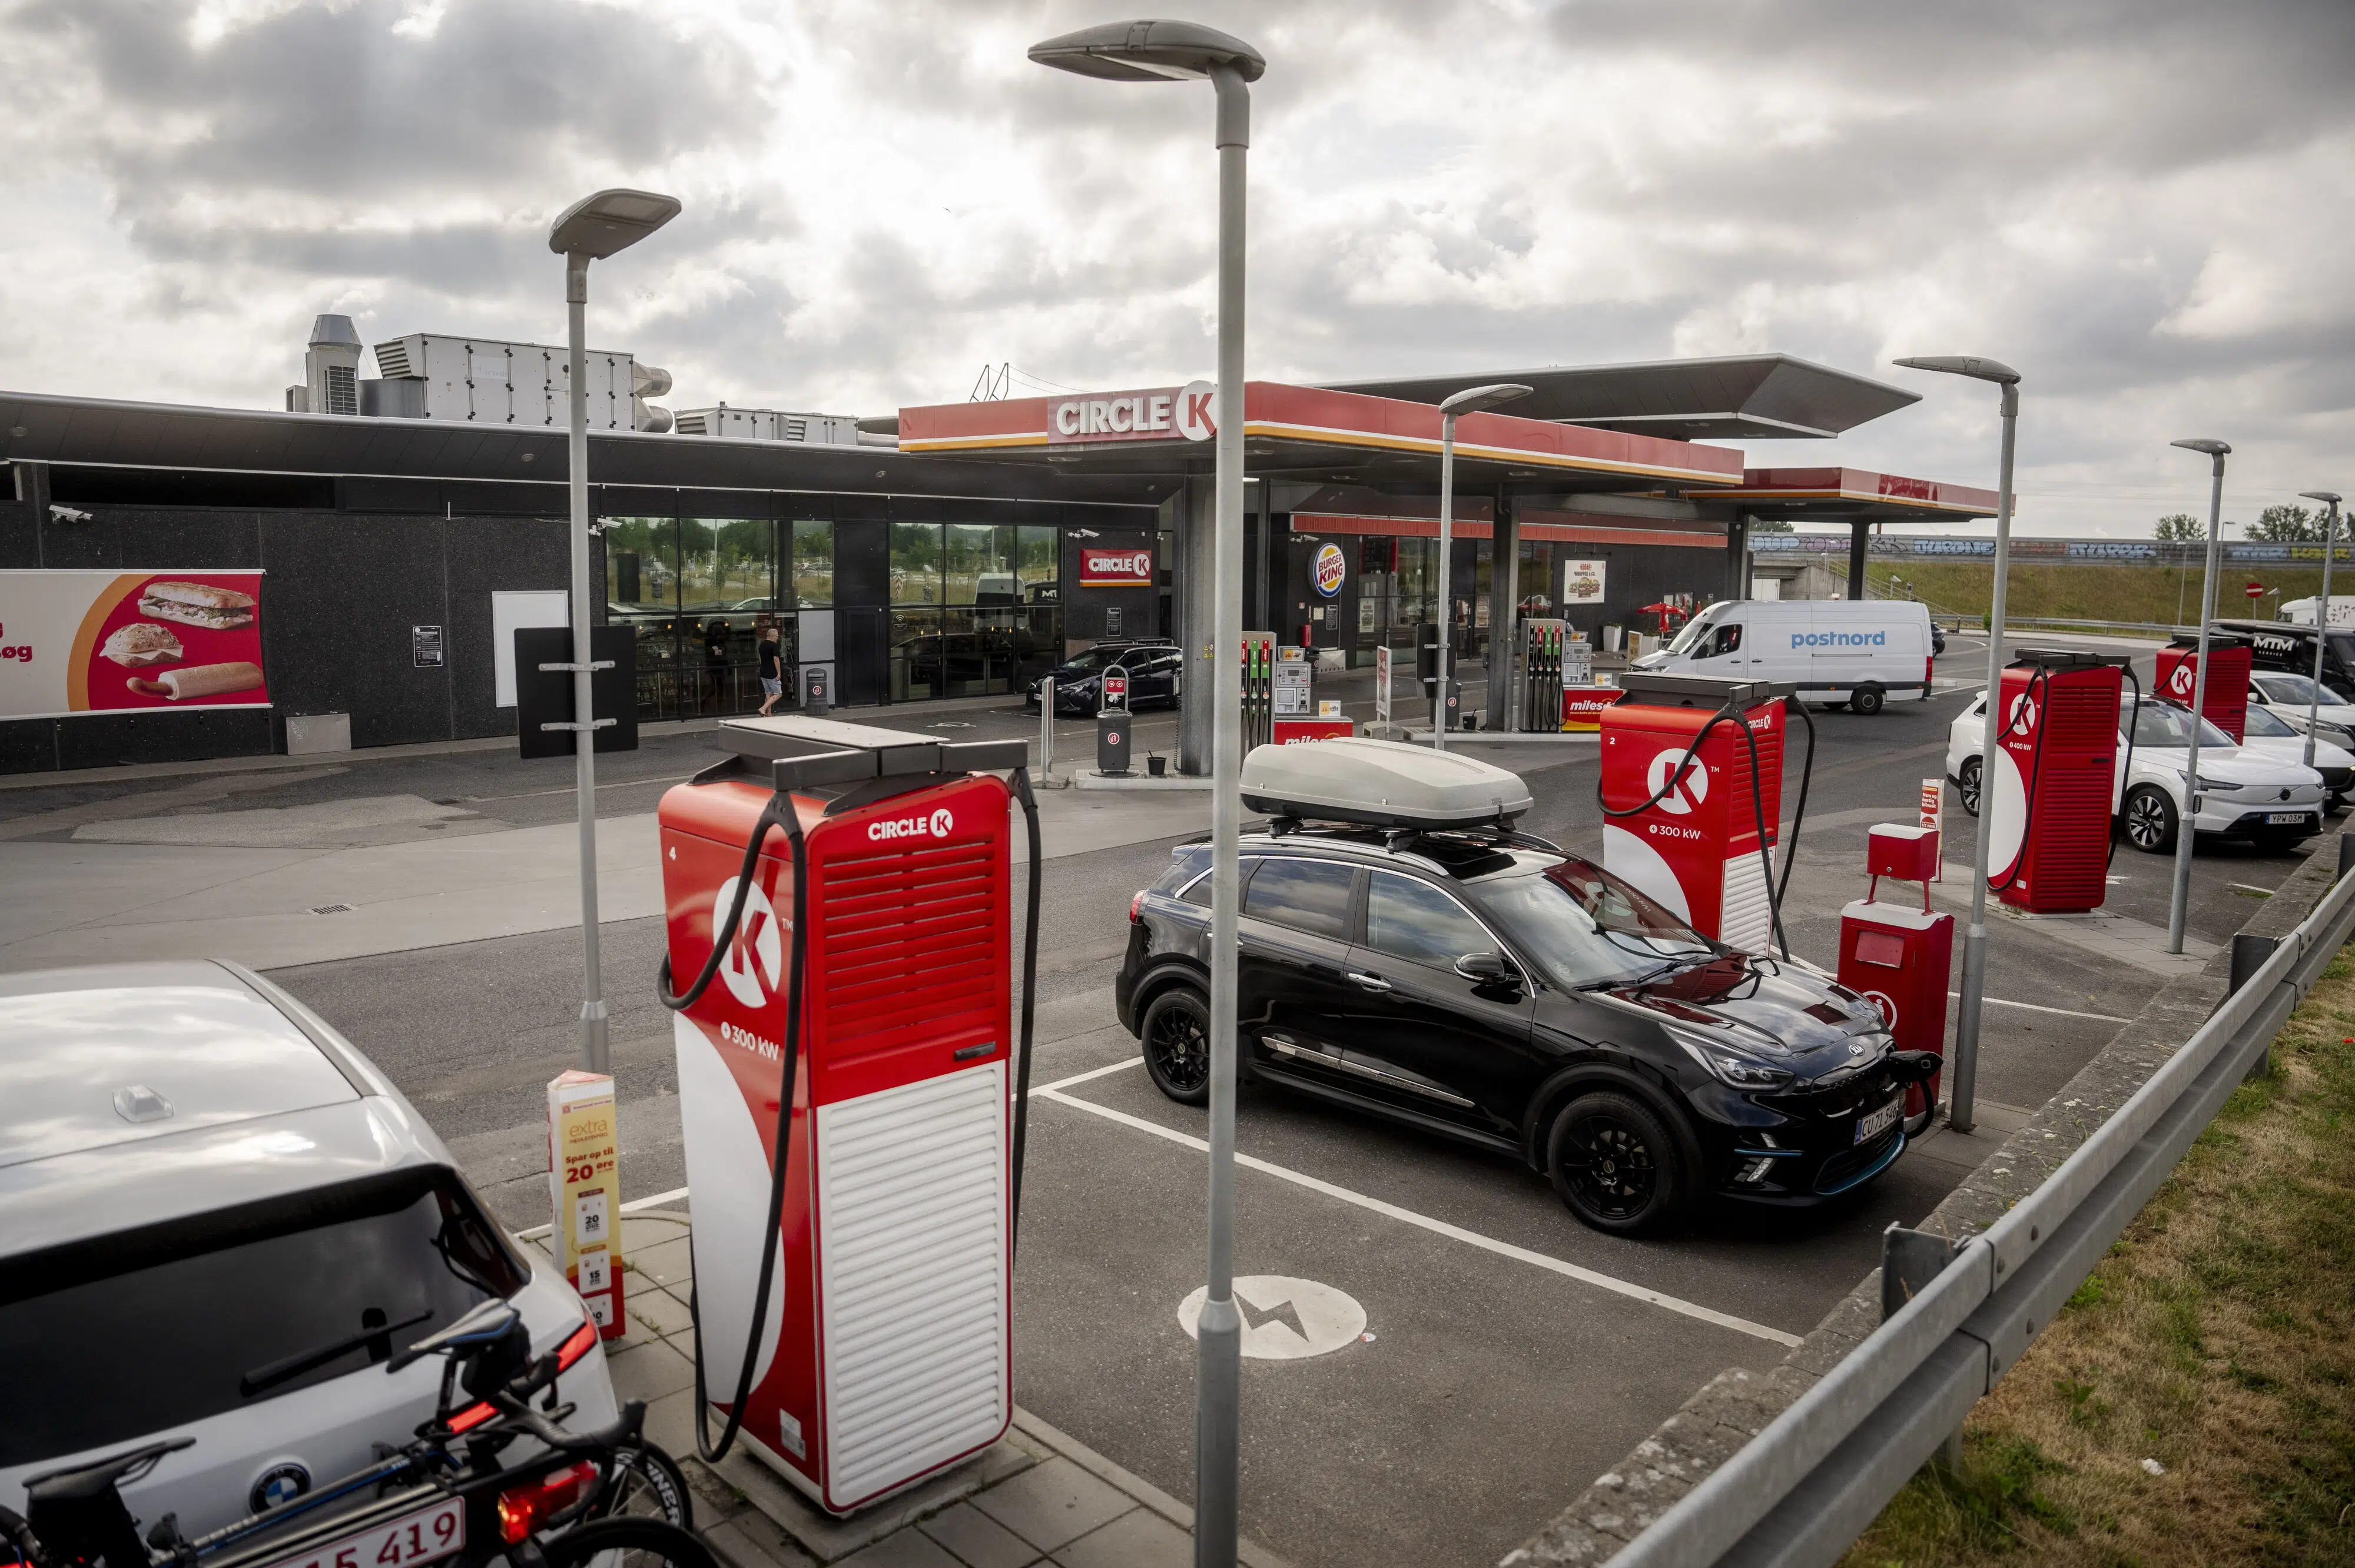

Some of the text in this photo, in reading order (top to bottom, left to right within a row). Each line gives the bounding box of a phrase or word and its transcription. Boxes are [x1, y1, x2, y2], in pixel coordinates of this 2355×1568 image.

[1057, 395, 1170, 435] CIRCLE
[1088, 557, 1132, 572] CIRCLE
[1318, 554, 1342, 573] BURGER
[1319, 563, 1343, 585] KING
[1791, 630, 1885, 649] postnord
[2253, 636, 2294, 652] MTM
[0, 645, 33, 663] øg
[1748, 719, 1764, 729] CIRCLE
[2272, 815, 2287, 823] YPW
[867, 817, 927, 841] CIRCLE
[1659, 825, 1701, 840] 300 kW
[668, 846, 676, 861] 4
[732, 1025, 779, 1061] 300 kW
[569, 1119, 608, 1137] extra
[1862, 1116, 1873, 1137] CU
[1873, 1112, 1883, 1130] 71
[570, 1132, 609, 1144] MEDLEMSPRIS
[565, 1147, 614, 1164] Spar op til
[566, 1158, 614, 1184] 20 øre
[585, 1214, 599, 1224] 20
[589, 1270, 601, 1280] 15
[376, 1510, 457, 1565] 419
